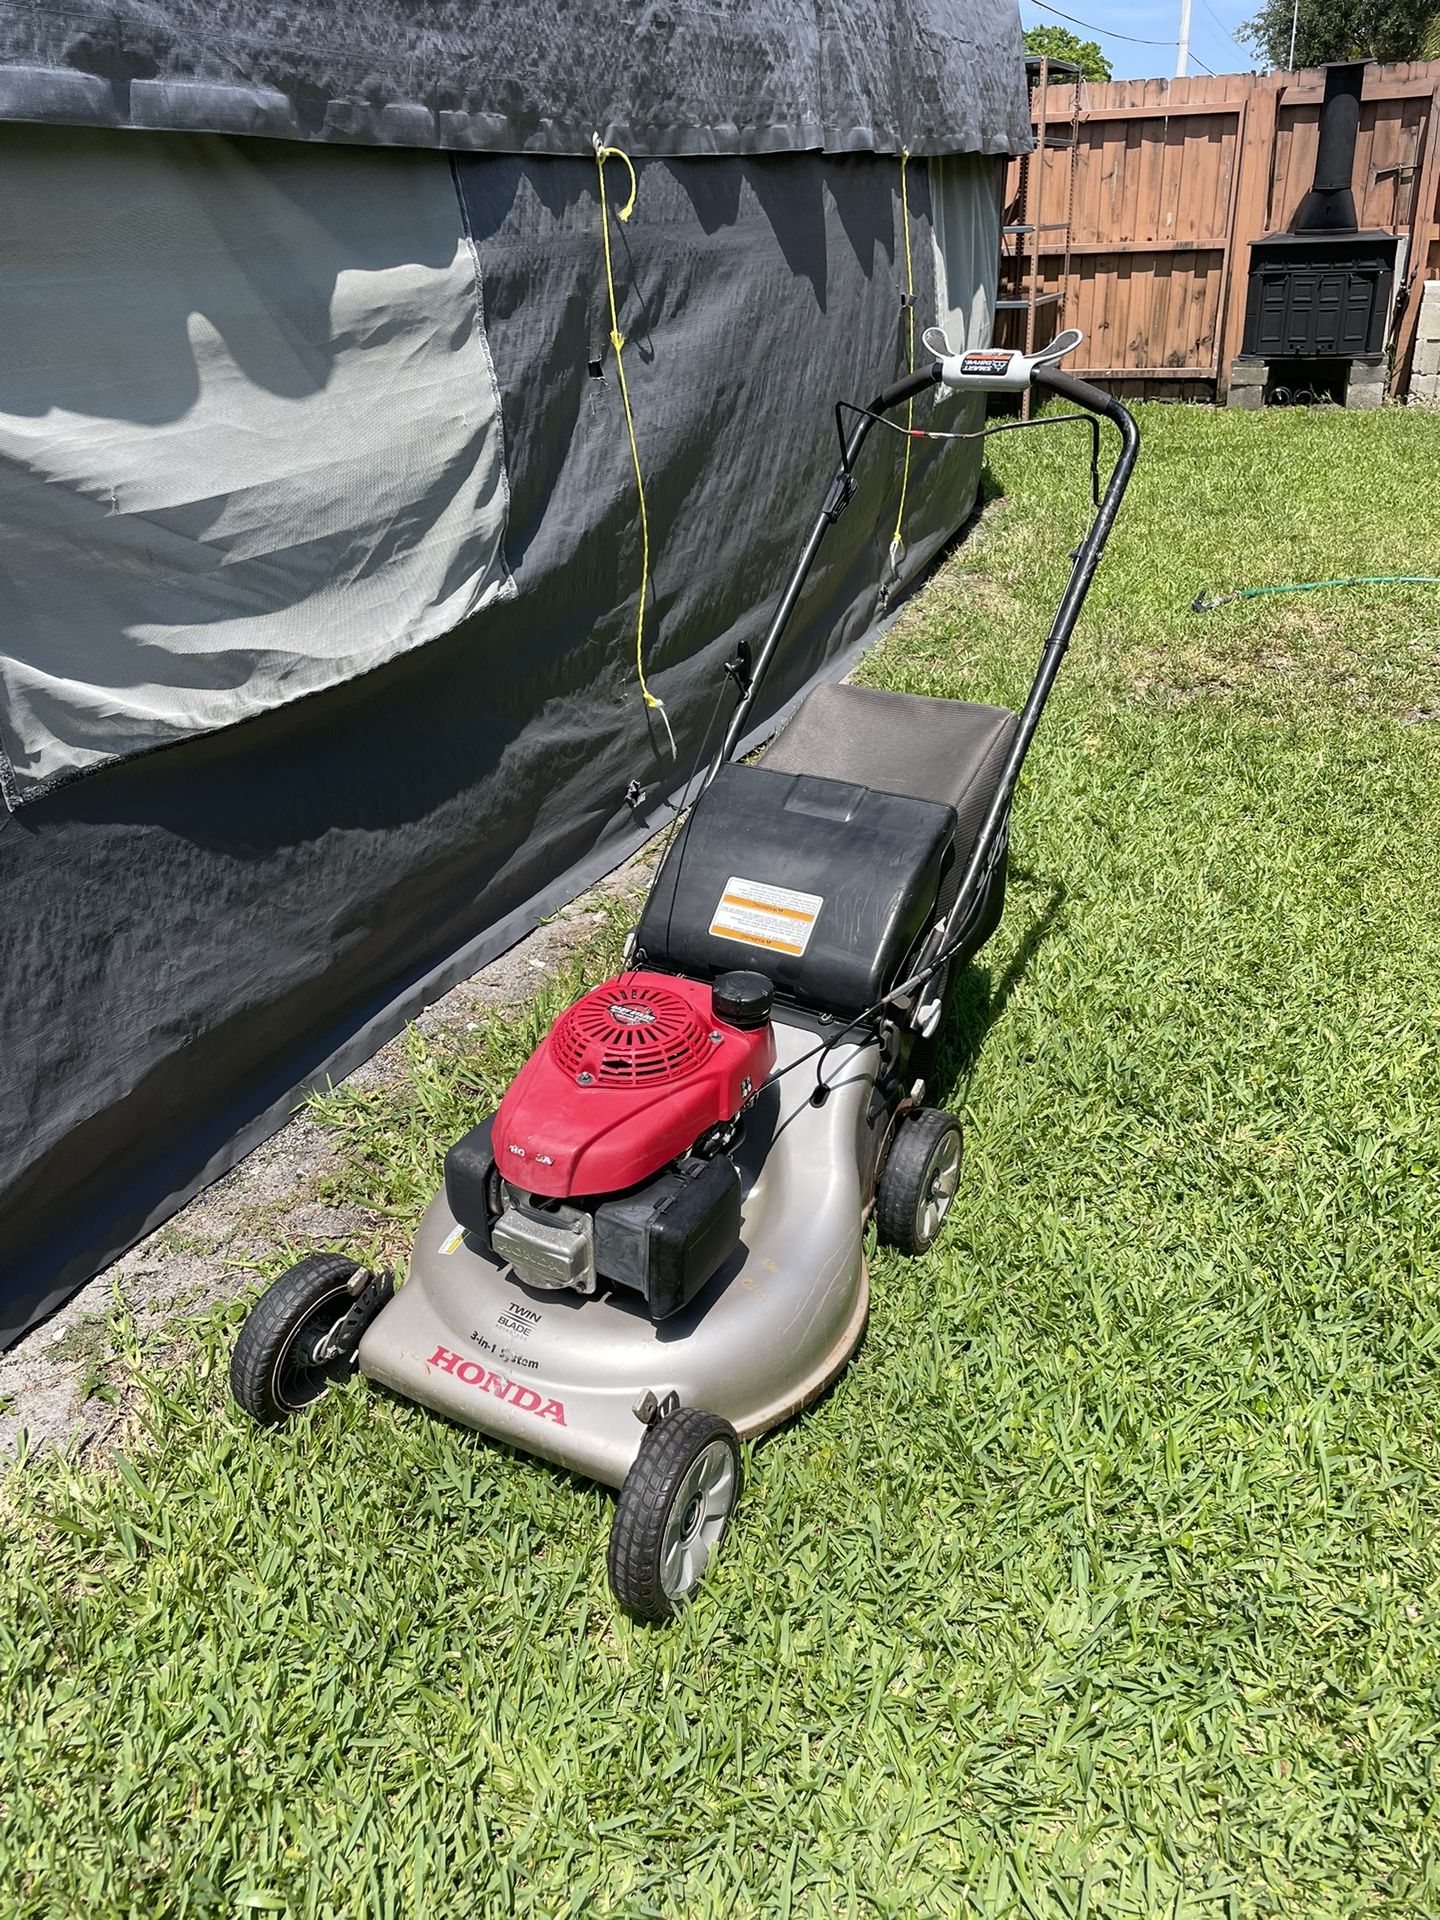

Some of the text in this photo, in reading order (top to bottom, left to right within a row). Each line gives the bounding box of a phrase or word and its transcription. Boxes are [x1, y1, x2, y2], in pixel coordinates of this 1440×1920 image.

[508, 1302, 542, 1323] TWIN
[497, 1316, 532, 1337] BLADE
[470, 1330, 497, 1353] 3-in-1
[427, 1345, 567, 1427] HONDA
